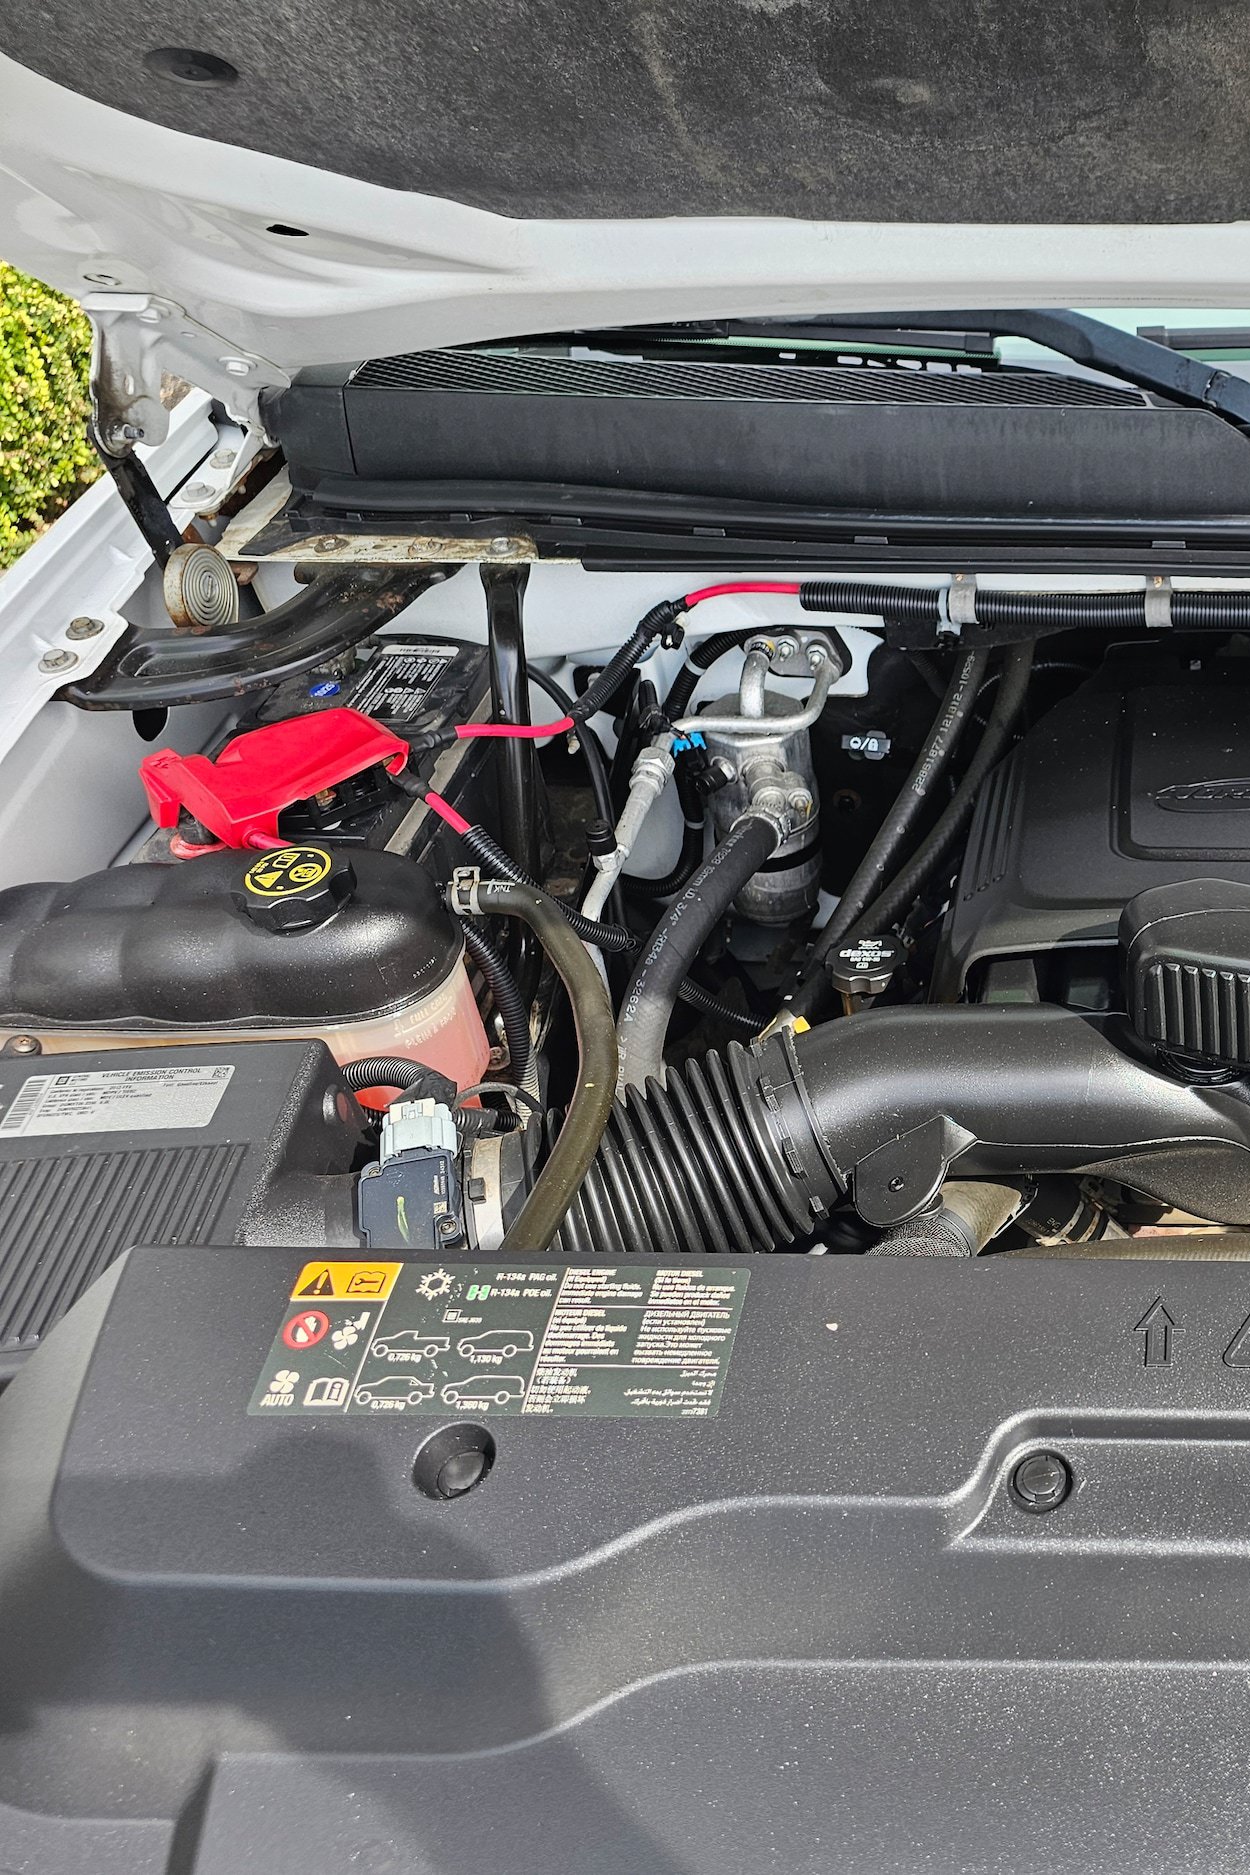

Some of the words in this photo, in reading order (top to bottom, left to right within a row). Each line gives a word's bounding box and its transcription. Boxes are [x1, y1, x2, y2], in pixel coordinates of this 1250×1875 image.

[623, 977, 646, 1023] 3262A
[132, 1069, 168, 1077] EMISSION
[496, 1273, 527, 1281] R-134a
[528, 1273, 546, 1281] PAG
[490, 1288, 521, 1297] R-134a
[522, 1288, 541, 1297] POE
[260, 1394, 295, 1407] AUTO
